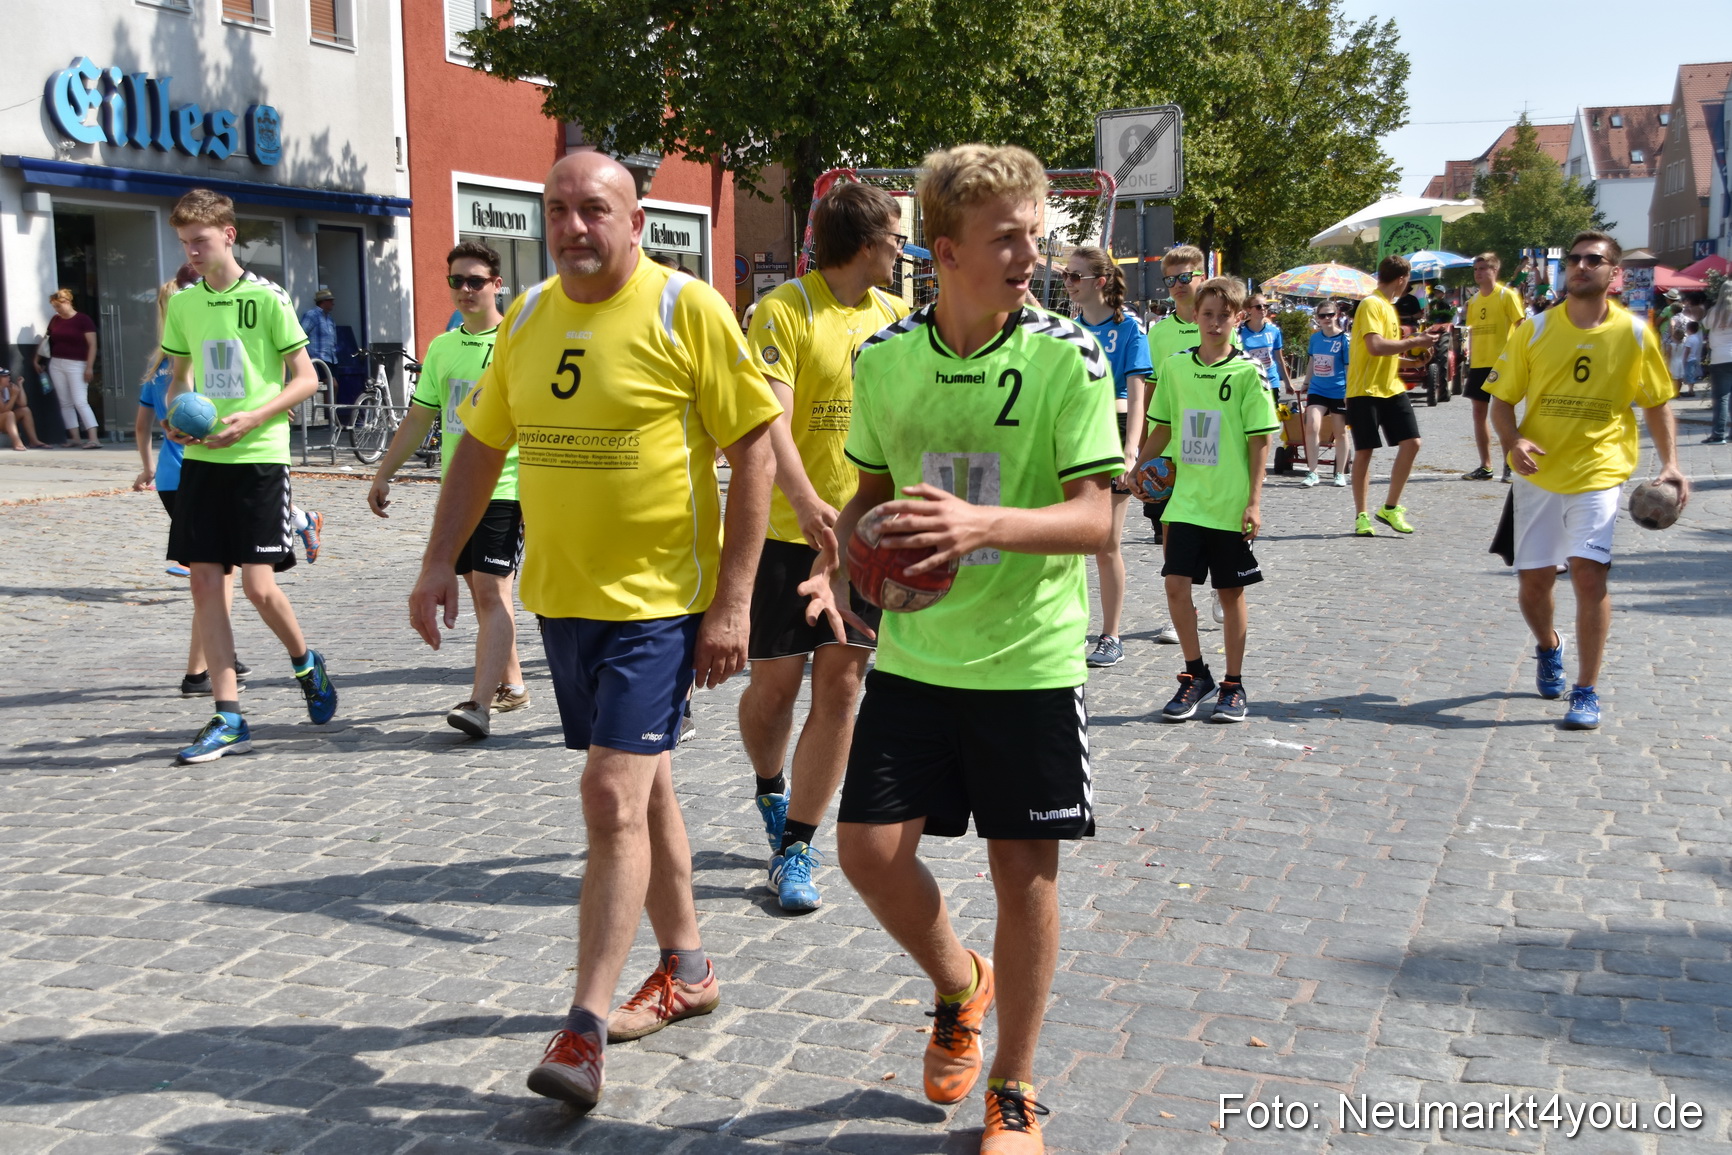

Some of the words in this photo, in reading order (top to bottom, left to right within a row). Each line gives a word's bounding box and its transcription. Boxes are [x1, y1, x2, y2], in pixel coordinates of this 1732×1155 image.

[45, 56, 238, 160] Eilles
[1120, 173, 1157, 188] ZONE
[472, 201, 526, 230] fielmann
[650, 222, 690, 247] fielmann
[236, 298, 258, 329] 10
[1480, 307, 1486, 320] 3
[461, 340, 484, 348] hummel
[565, 330, 593, 340] SELECT
[1104, 329, 1118, 353] 3
[1330, 340, 1342, 353] 13
[551, 348, 586, 400] 5
[935, 371, 985, 384] hummel
[1573, 356, 1591, 383] 6
[205, 373, 245, 389] USM
[1219, 374, 1232, 402] 6
[994, 368, 1023, 426] 2
[1182, 440, 1217, 456] USM
[1029, 803, 1081, 821] hummel
